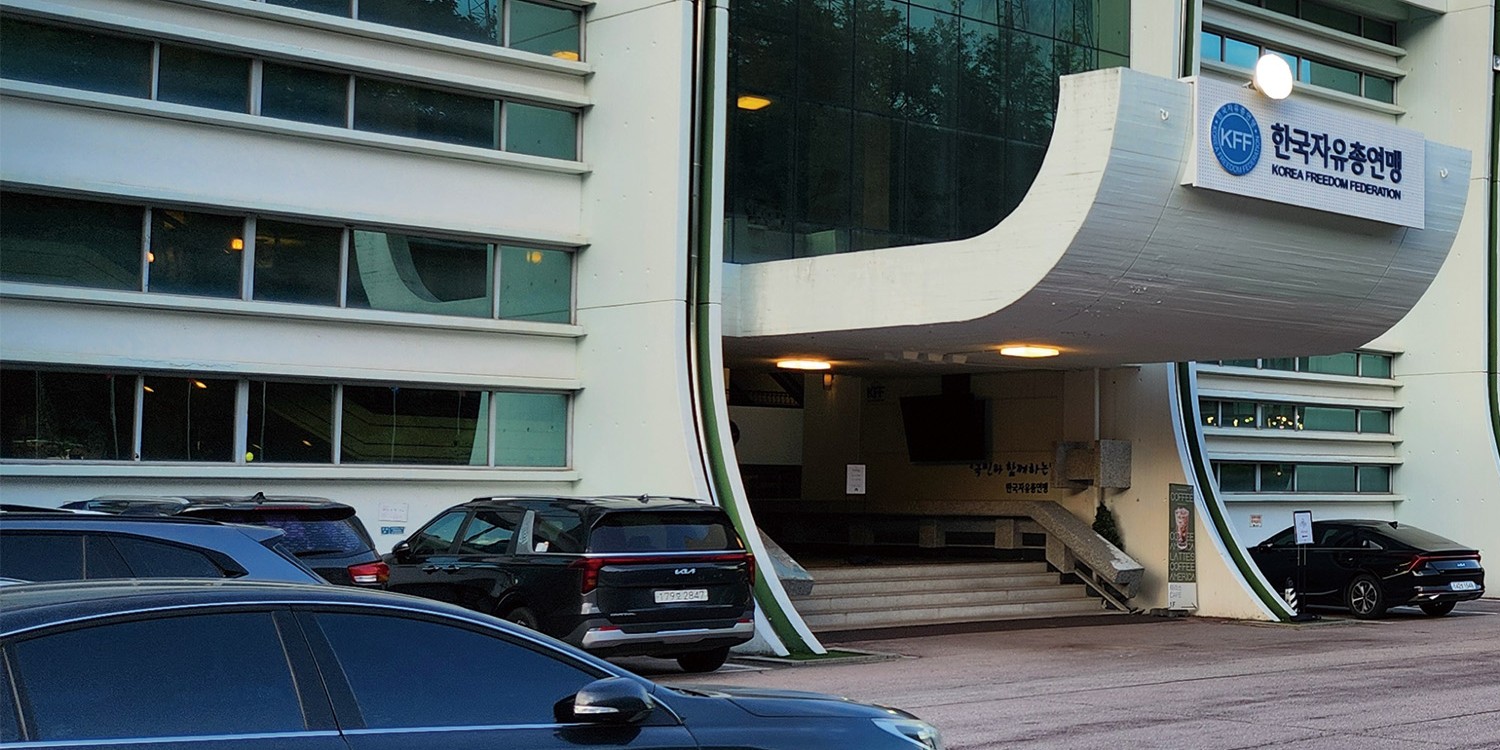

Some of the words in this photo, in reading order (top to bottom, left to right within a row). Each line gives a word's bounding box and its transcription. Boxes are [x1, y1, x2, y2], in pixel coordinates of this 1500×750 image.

[1221, 128, 1253, 151] KFF
[1271, 122, 1402, 183] 한국자유총연맹
[1272, 164, 1304, 180] KOREA
[1305, 171, 1348, 190] FREEDOM
[1350, 180, 1401, 200] FEDERATION
[1171, 492, 1194, 502] COFFEE
[1170, 532, 1194, 542] COEE
[1170, 552, 1195, 561] LATTES
[1170, 562, 1195, 571] COFFEE
[683, 591, 705, 600] 2847
